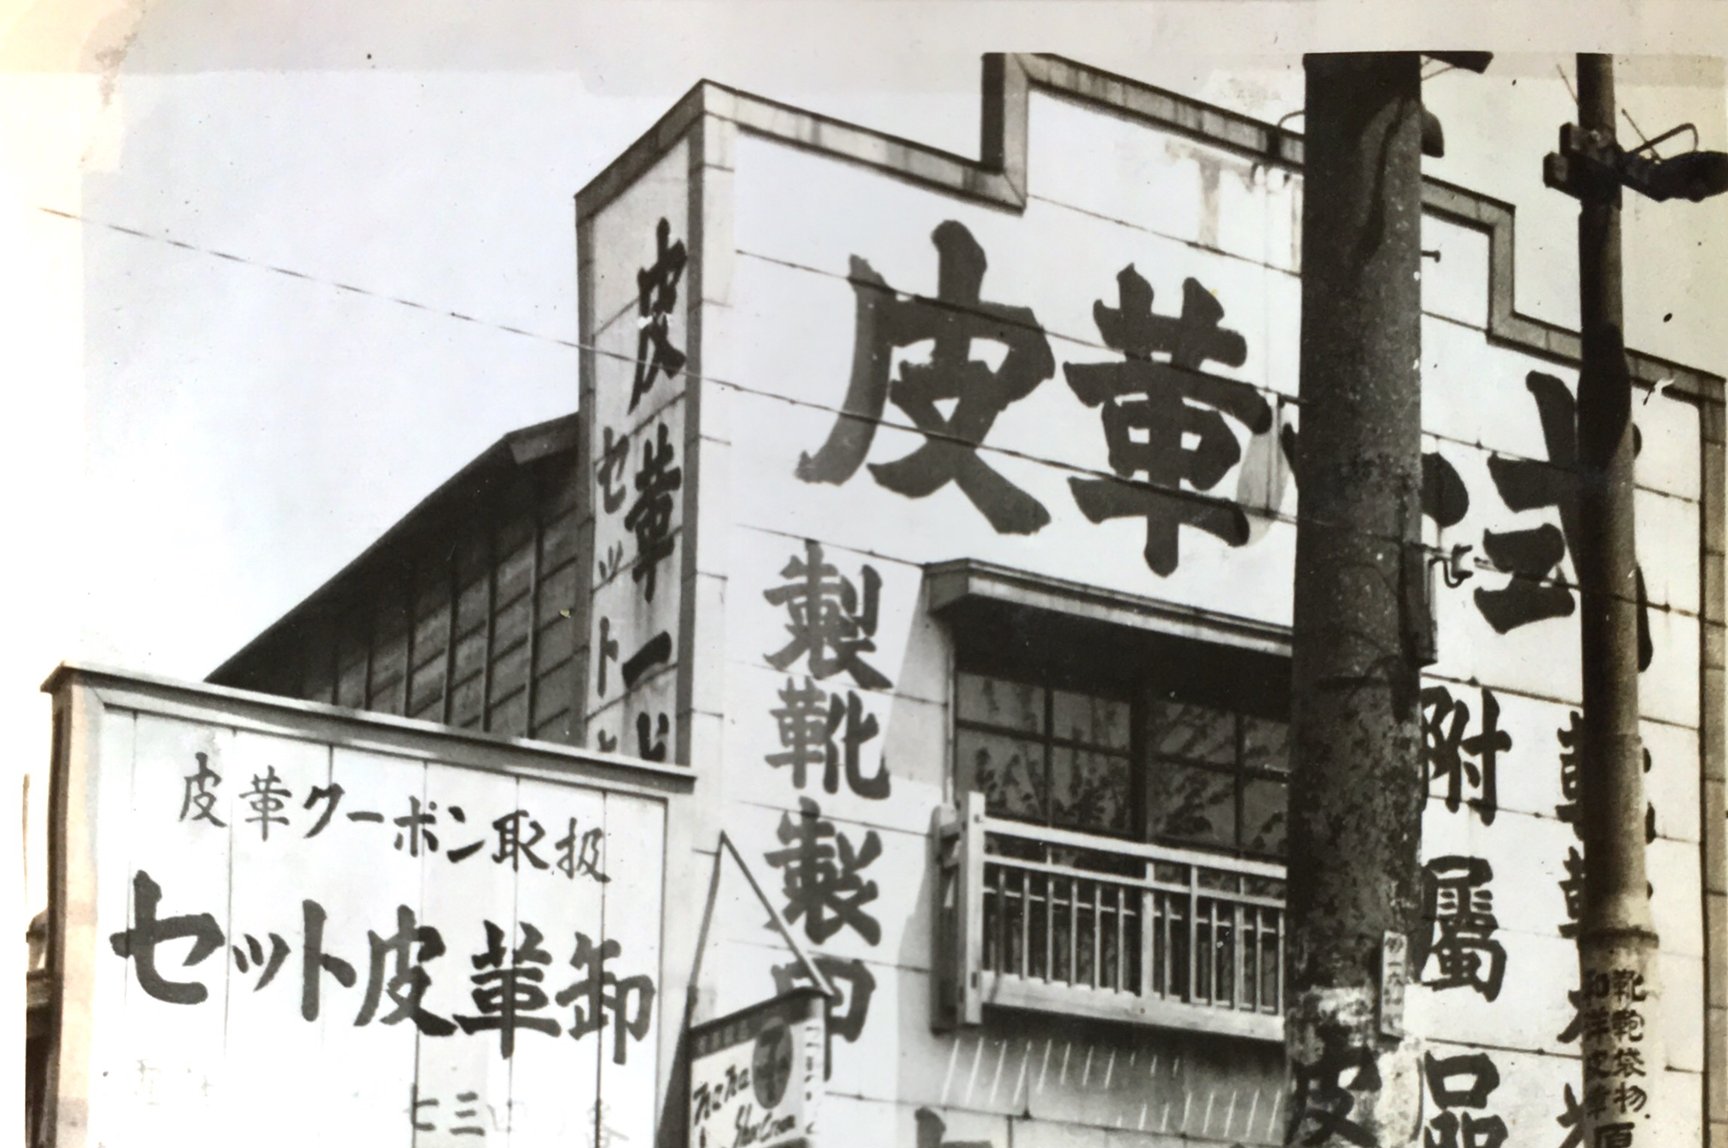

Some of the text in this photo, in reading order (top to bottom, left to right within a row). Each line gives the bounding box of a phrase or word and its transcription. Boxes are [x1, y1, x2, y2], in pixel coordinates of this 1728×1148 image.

[179, 753, 611, 883] 皮革クーポン取扱
[109, 870, 656, 1065] セット皮革卸
